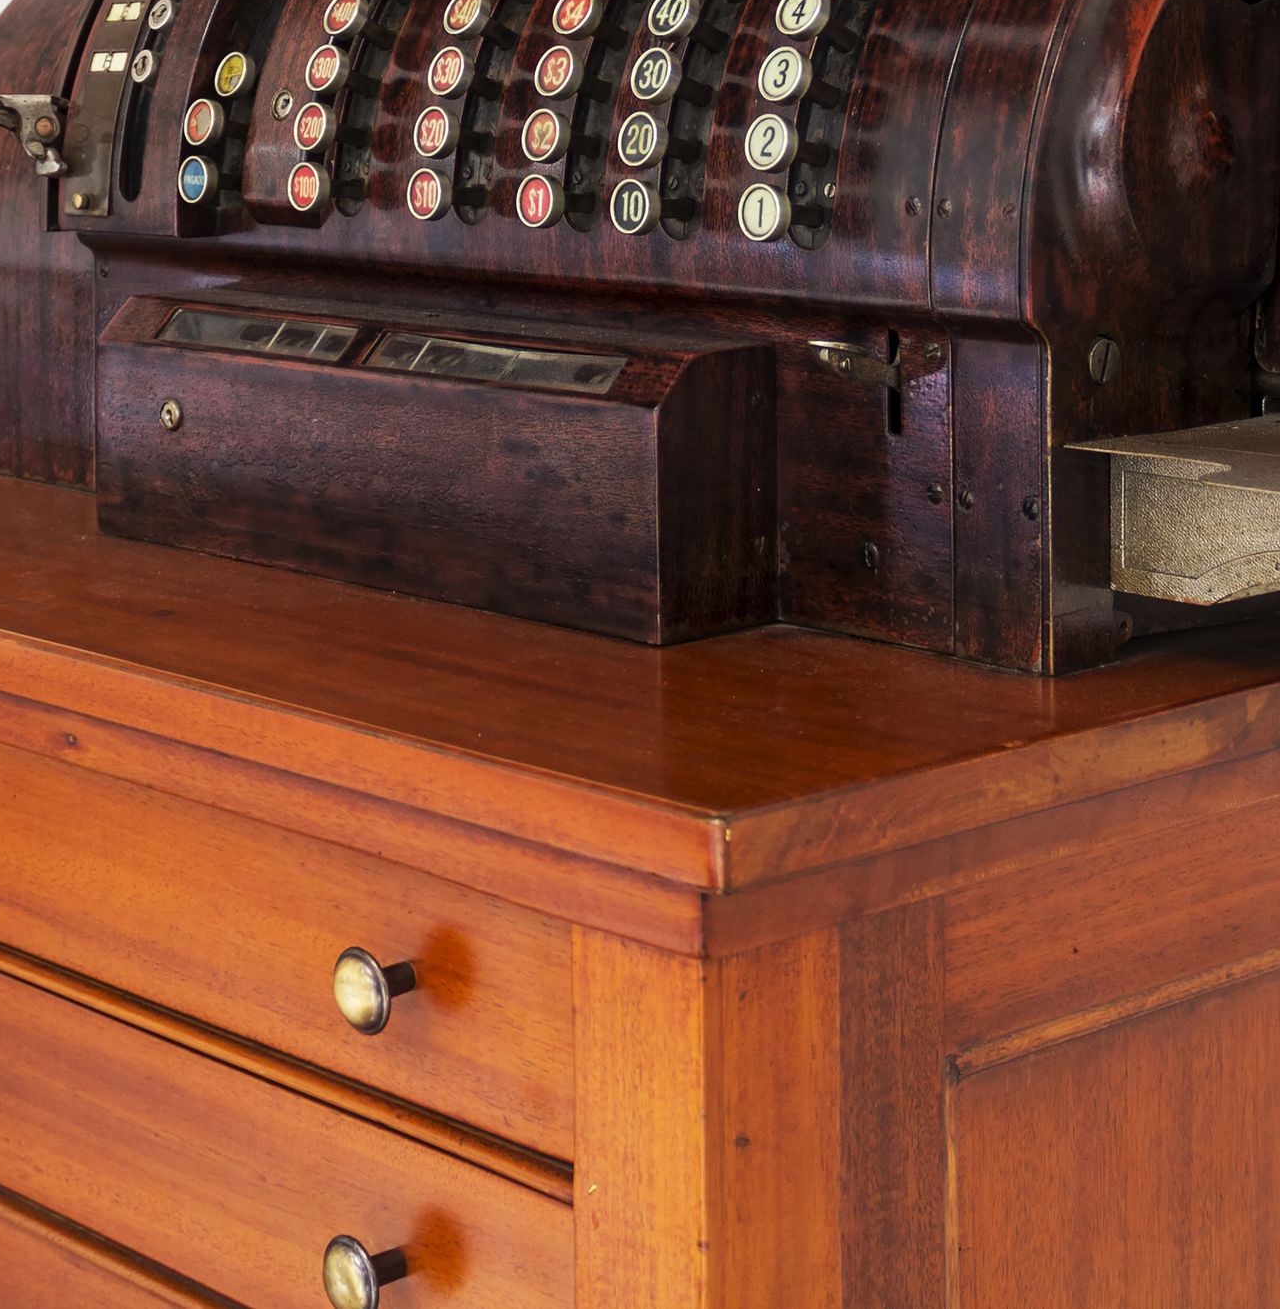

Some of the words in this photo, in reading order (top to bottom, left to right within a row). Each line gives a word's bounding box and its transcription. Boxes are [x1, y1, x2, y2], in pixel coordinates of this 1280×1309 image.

[331, 2, 356, 23] $400
[450, 0, 478, 23] $40
[562, 0, 586, 26] $4
[656, 0, 685, 26] 40
[312, 58, 337, 78] $300
[434, 57, 459, 84] $30
[543, 57, 567, 85] $3
[639, 58, 666, 89] 30
[773, 58, 790, 89] 3
[420, 120, 445, 146] $20
[531, 121, 557, 152] $2
[626, 124, 652, 155] 20
[760, 125, 776, 158] 2
[294, 177, 316, 199] $100
[415, 181, 437, 208] $10
[527, 187, 543, 217] $1
[623, 190, 642, 221] 10
[756, 196, 764, 228] 1
